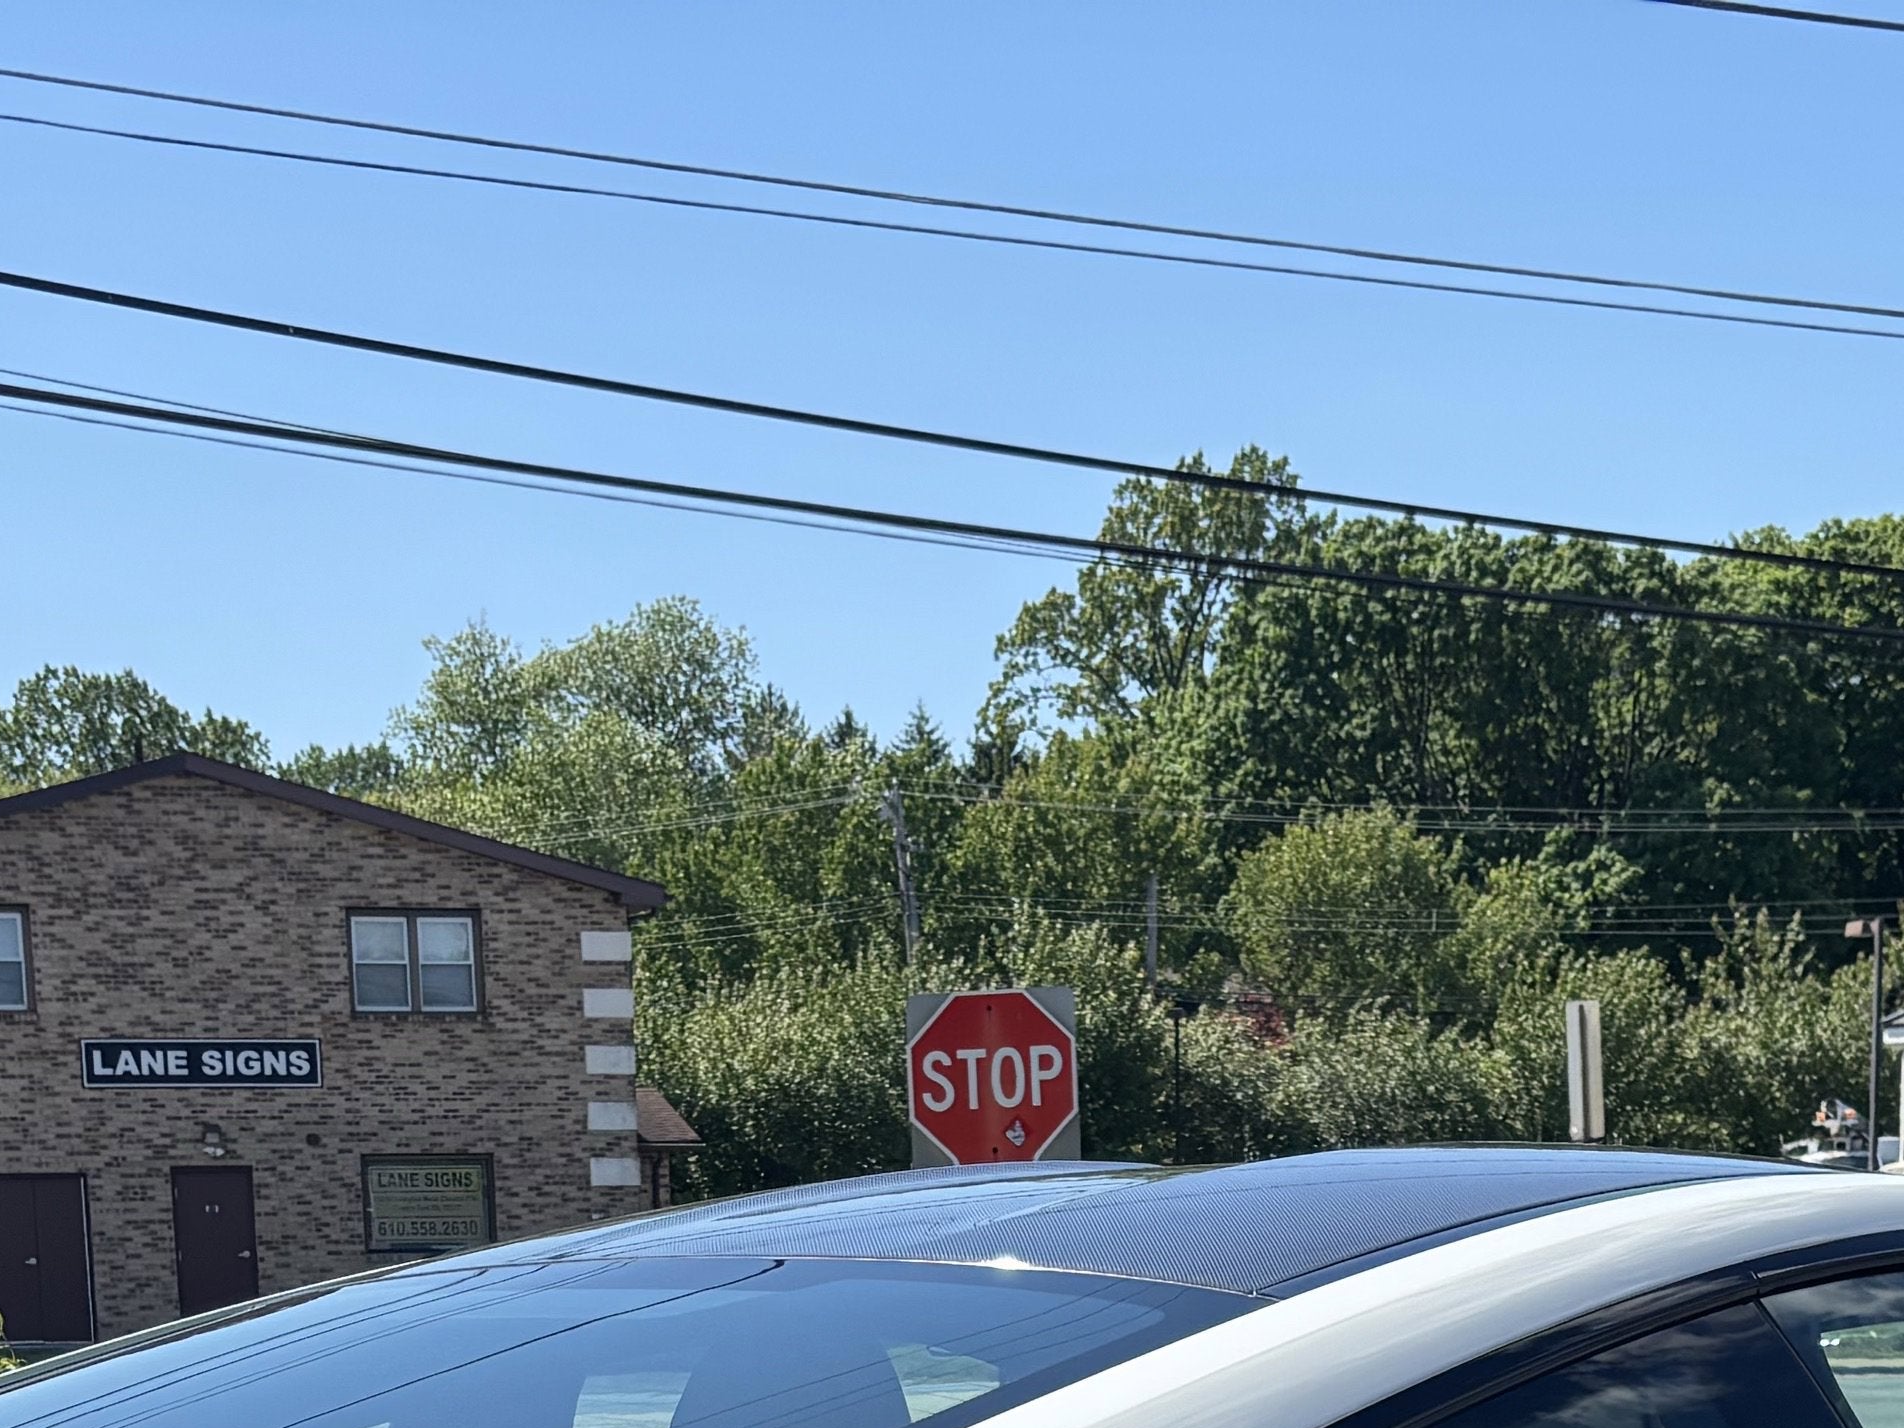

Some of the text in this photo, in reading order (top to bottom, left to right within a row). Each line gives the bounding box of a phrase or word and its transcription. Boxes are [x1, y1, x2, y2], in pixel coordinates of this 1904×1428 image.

[92, 1049, 311, 1076] LANE SIGNS
[922, 1044, 1063, 1112] STOP
[377, 1172, 473, 1188] LANE SIGNS
[378, 1220, 478, 1236] 610.558.2630
